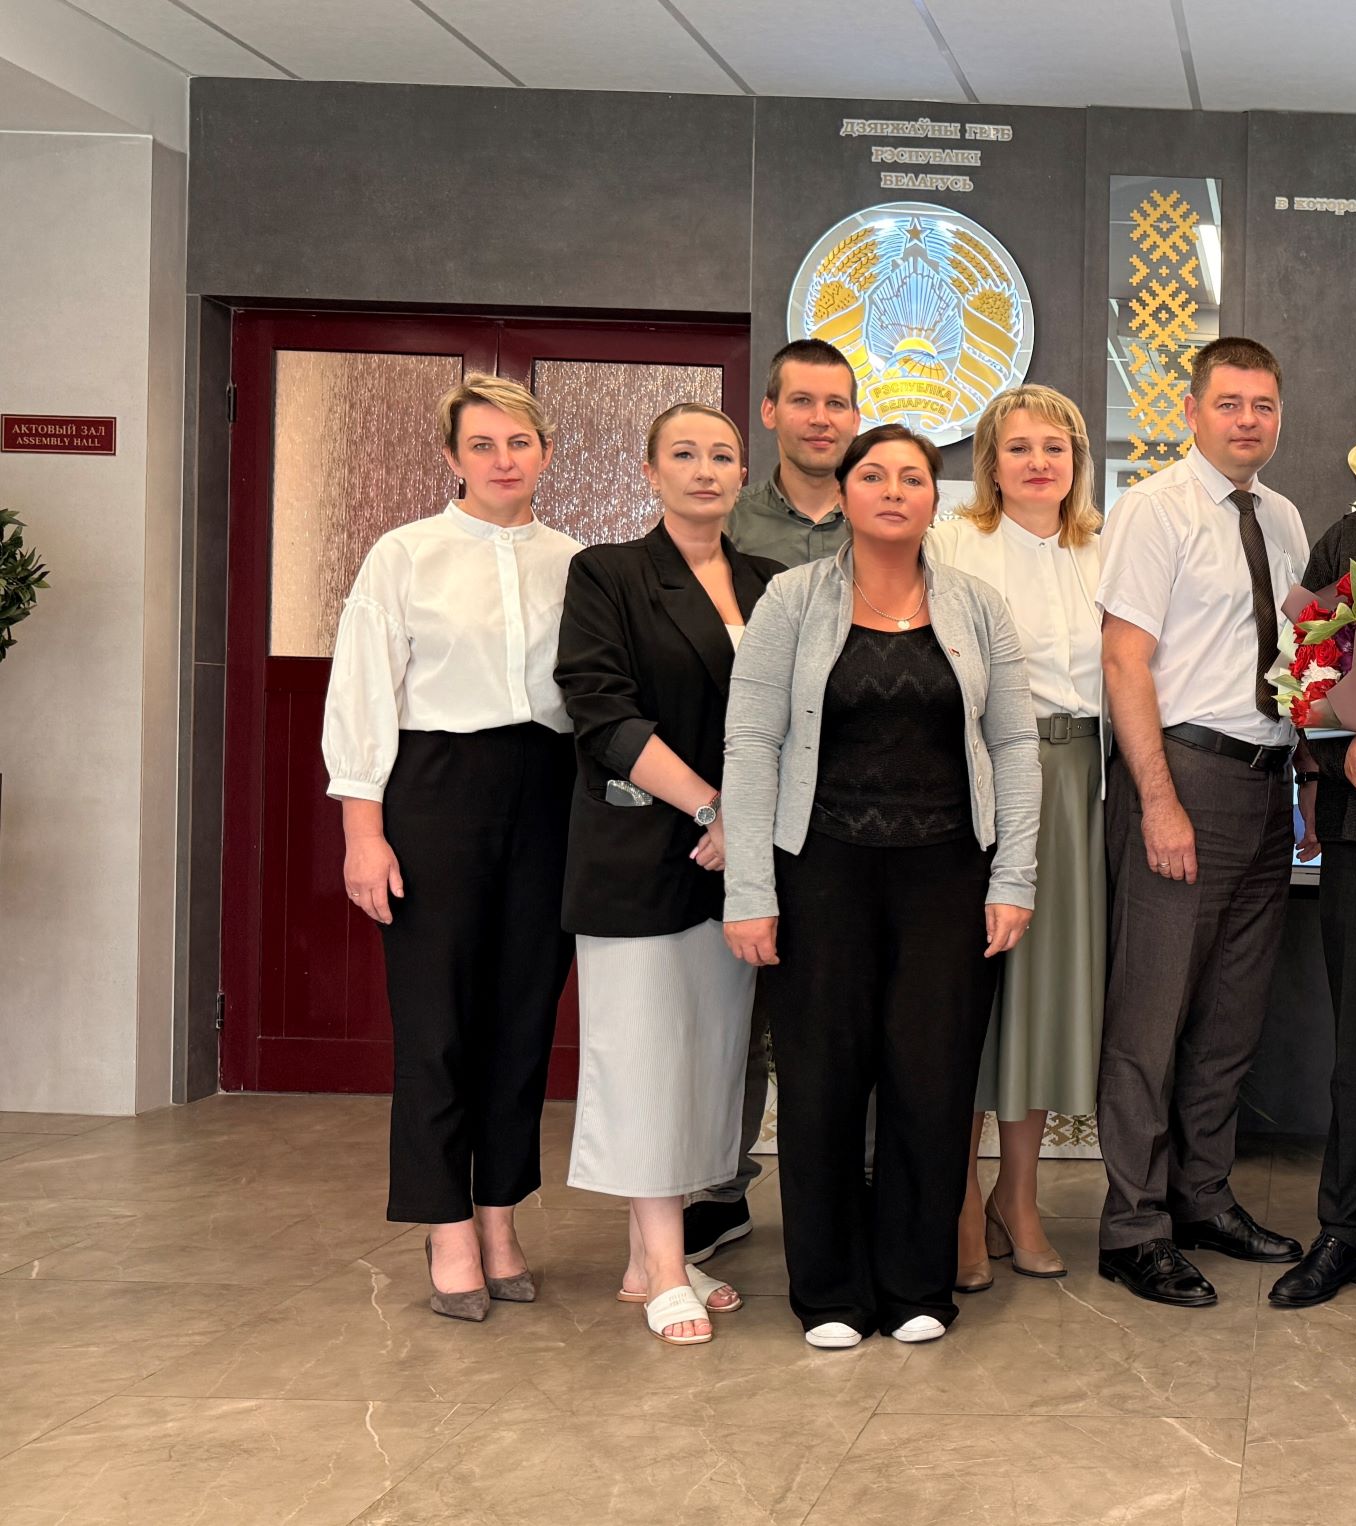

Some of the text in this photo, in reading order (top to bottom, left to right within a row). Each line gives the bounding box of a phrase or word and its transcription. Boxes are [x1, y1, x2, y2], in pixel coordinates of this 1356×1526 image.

[840, 118, 1012, 141] ДЗЯРЖАЎНЫ ГЕРБ
[872, 146, 981, 166] РЭСПУБЛІКІ
[881, 172, 973, 191] БЕЛАРУСЬ
[1275, 196, 1288, 210] в
[872, 381, 952, 402] РЭСПУБЛІКА
[880, 397, 948, 416] БЕЛАРУСЬ
[12, 424, 105, 436] АКТОВЫЙ ЗАЛ
[16, 437, 101, 447] ASSEMBLY HALL
